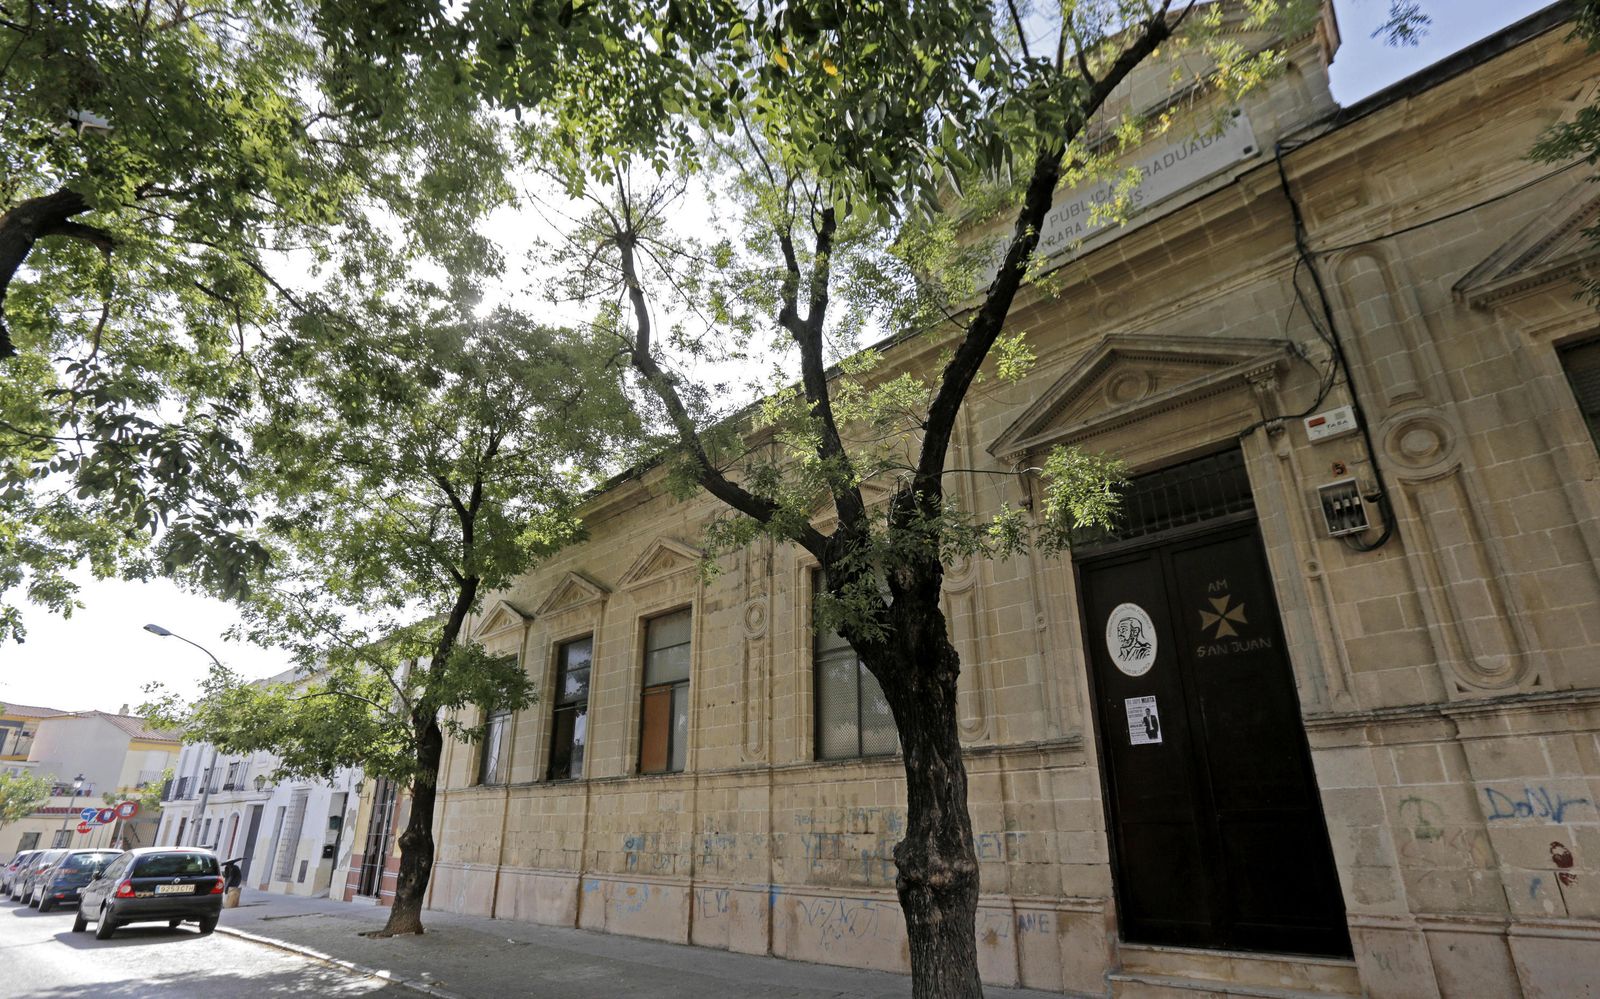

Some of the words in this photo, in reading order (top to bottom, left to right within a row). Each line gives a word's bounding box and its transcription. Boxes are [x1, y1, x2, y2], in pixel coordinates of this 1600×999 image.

[1138, 131, 1226, 177] RADUADA
[1208, 579, 1228, 592] AM
[1197, 643, 1228, 657] SAN
[1231, 637, 1272, 653] JUAN
